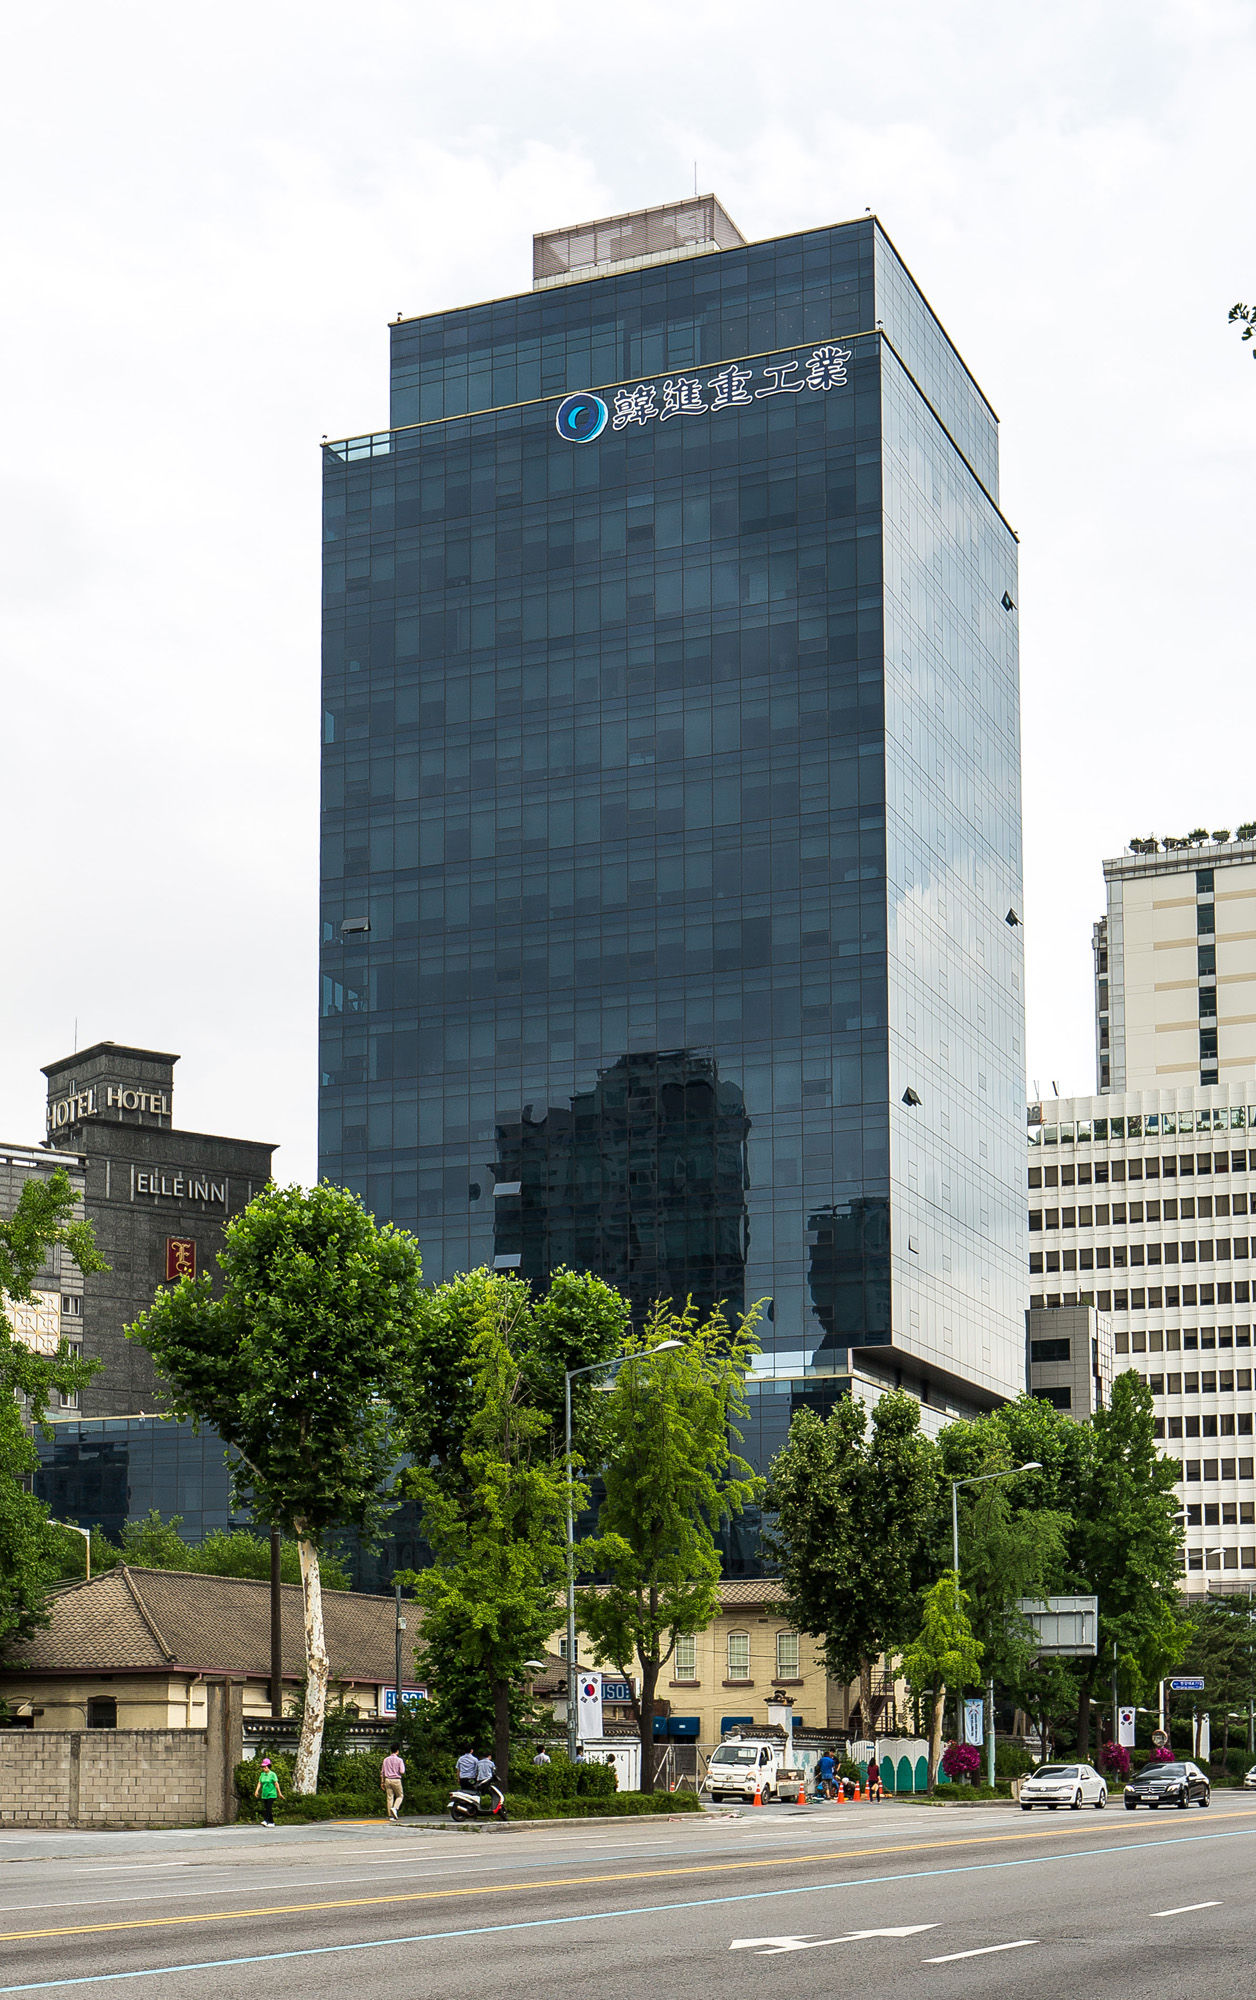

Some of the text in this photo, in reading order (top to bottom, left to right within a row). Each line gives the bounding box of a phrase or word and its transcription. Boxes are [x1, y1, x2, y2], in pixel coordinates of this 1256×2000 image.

[612, 345, 852, 431] 韓進重工業
[46, 1089, 98, 1132] HOTEL
[107, 1086, 171, 1115] HOTEL
[137, 1173, 225, 1202] ELLE INN
